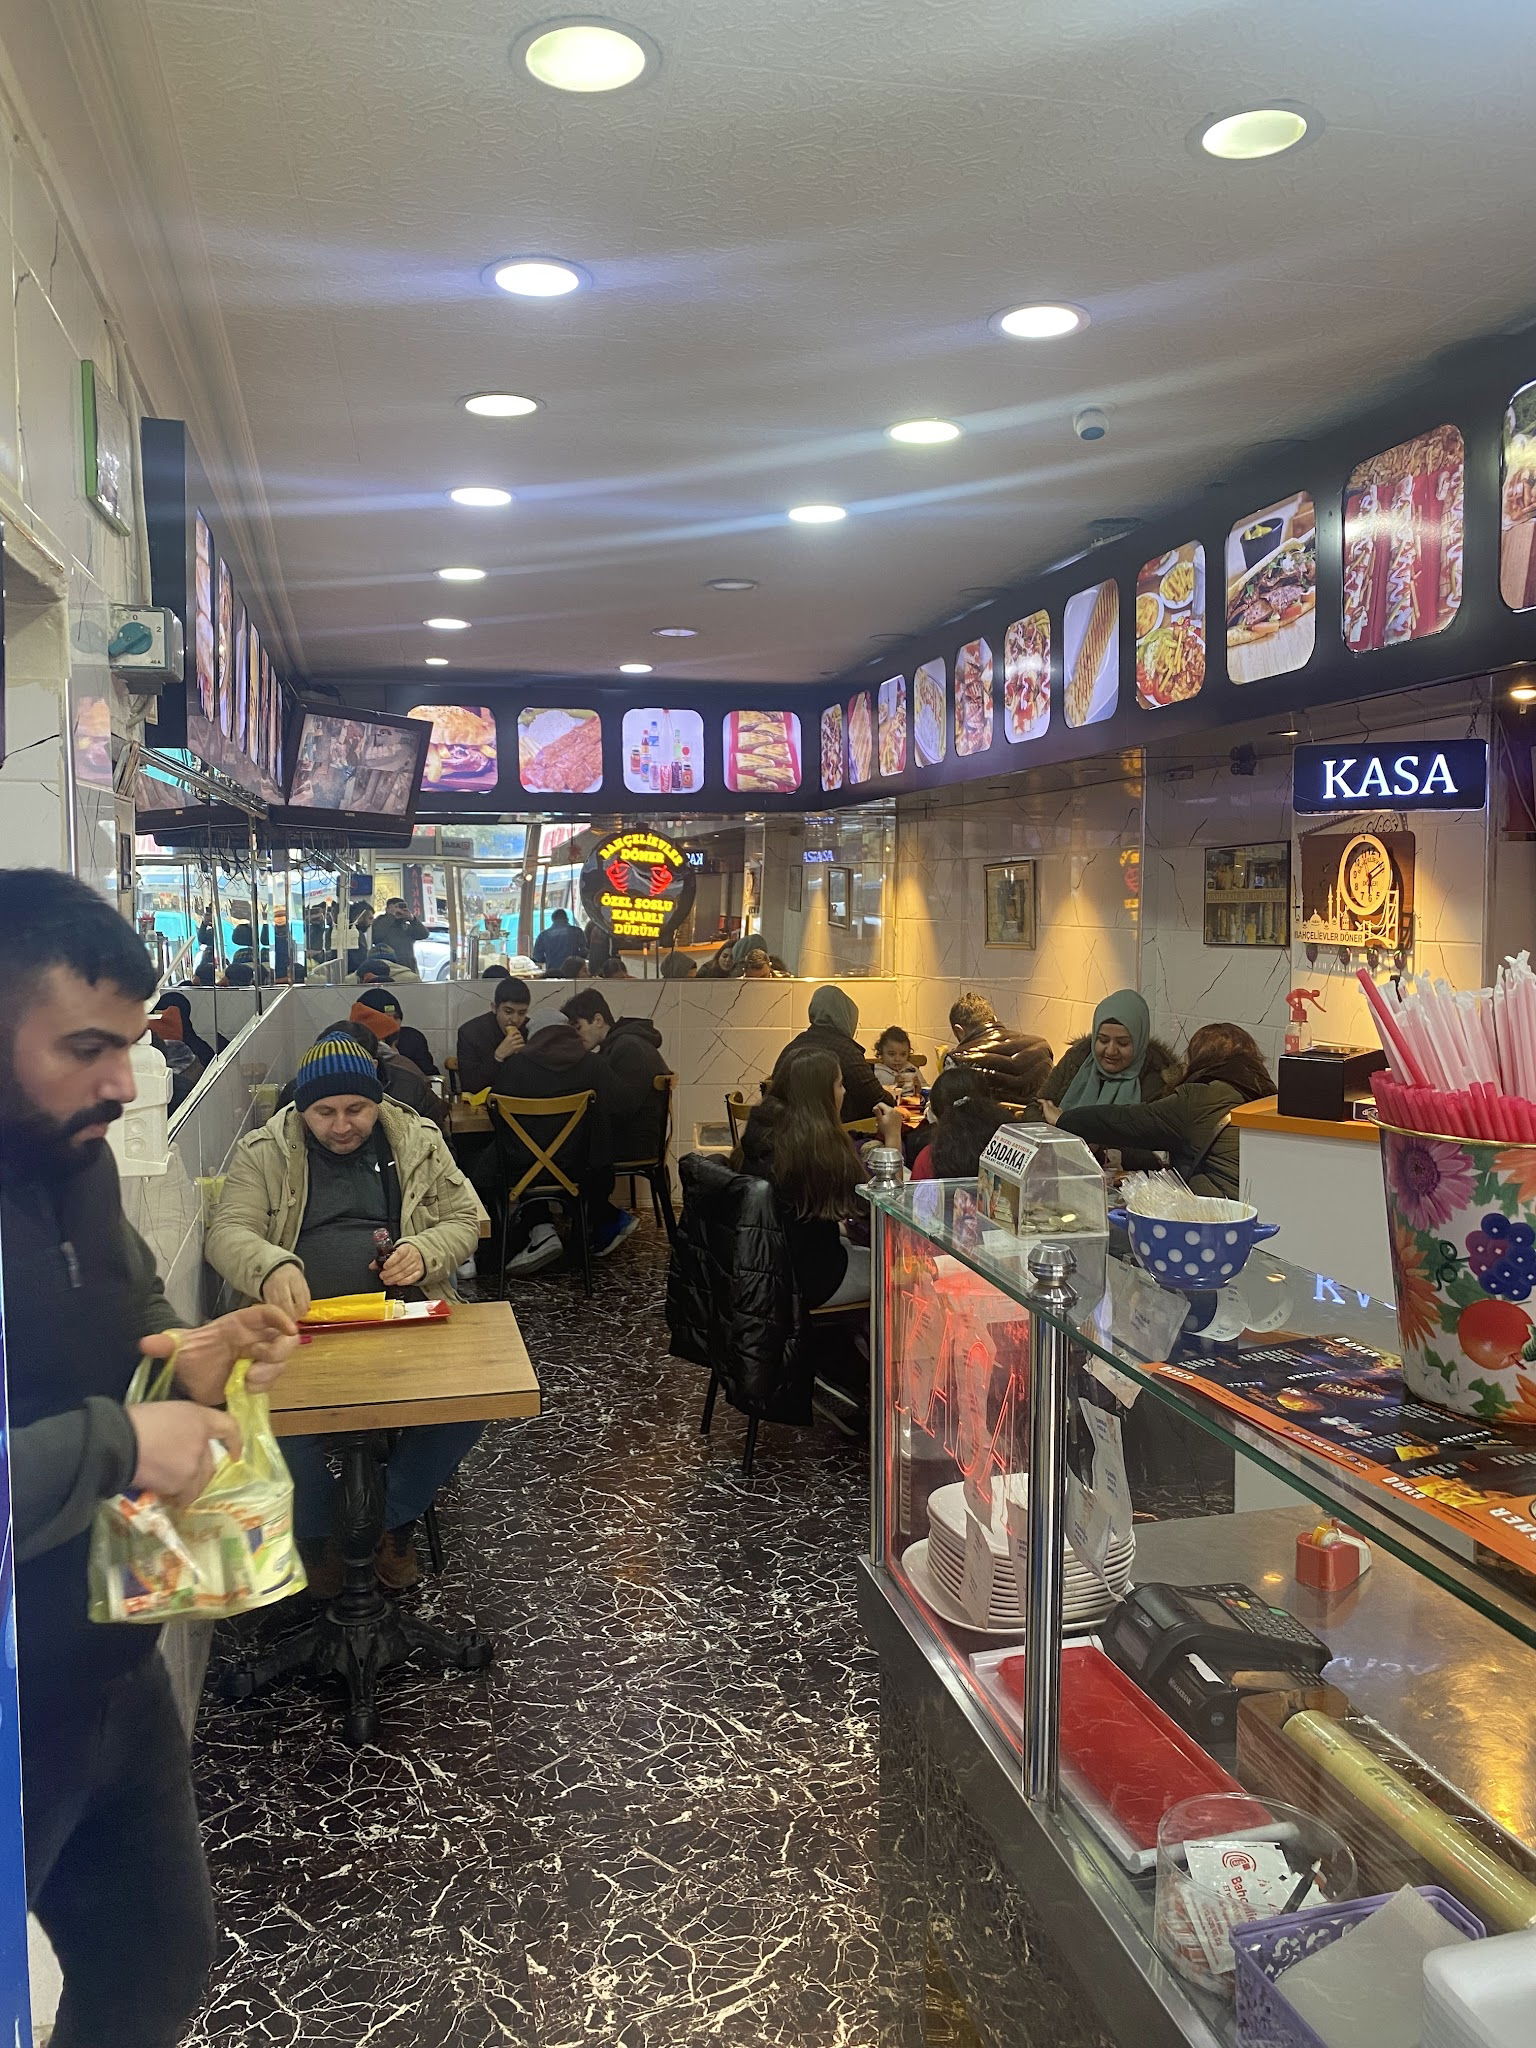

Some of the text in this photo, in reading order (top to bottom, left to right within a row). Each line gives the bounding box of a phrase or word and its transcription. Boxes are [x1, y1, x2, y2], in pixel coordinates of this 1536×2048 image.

[1322, 753, 1459, 799] KASA
[599, 832, 684, 867] BAHÇELİEVLER
[620, 847, 665, 864] DÖNER
[601, 892, 674, 912] ÖZEL SOSLU
[613, 922, 660, 938] DÜRÜM
[1339, 931, 1363, 943] DÖNER
[987, 1140, 1026, 1171] SADAKA
[1381, 1476, 1427, 1500] DÖNER
